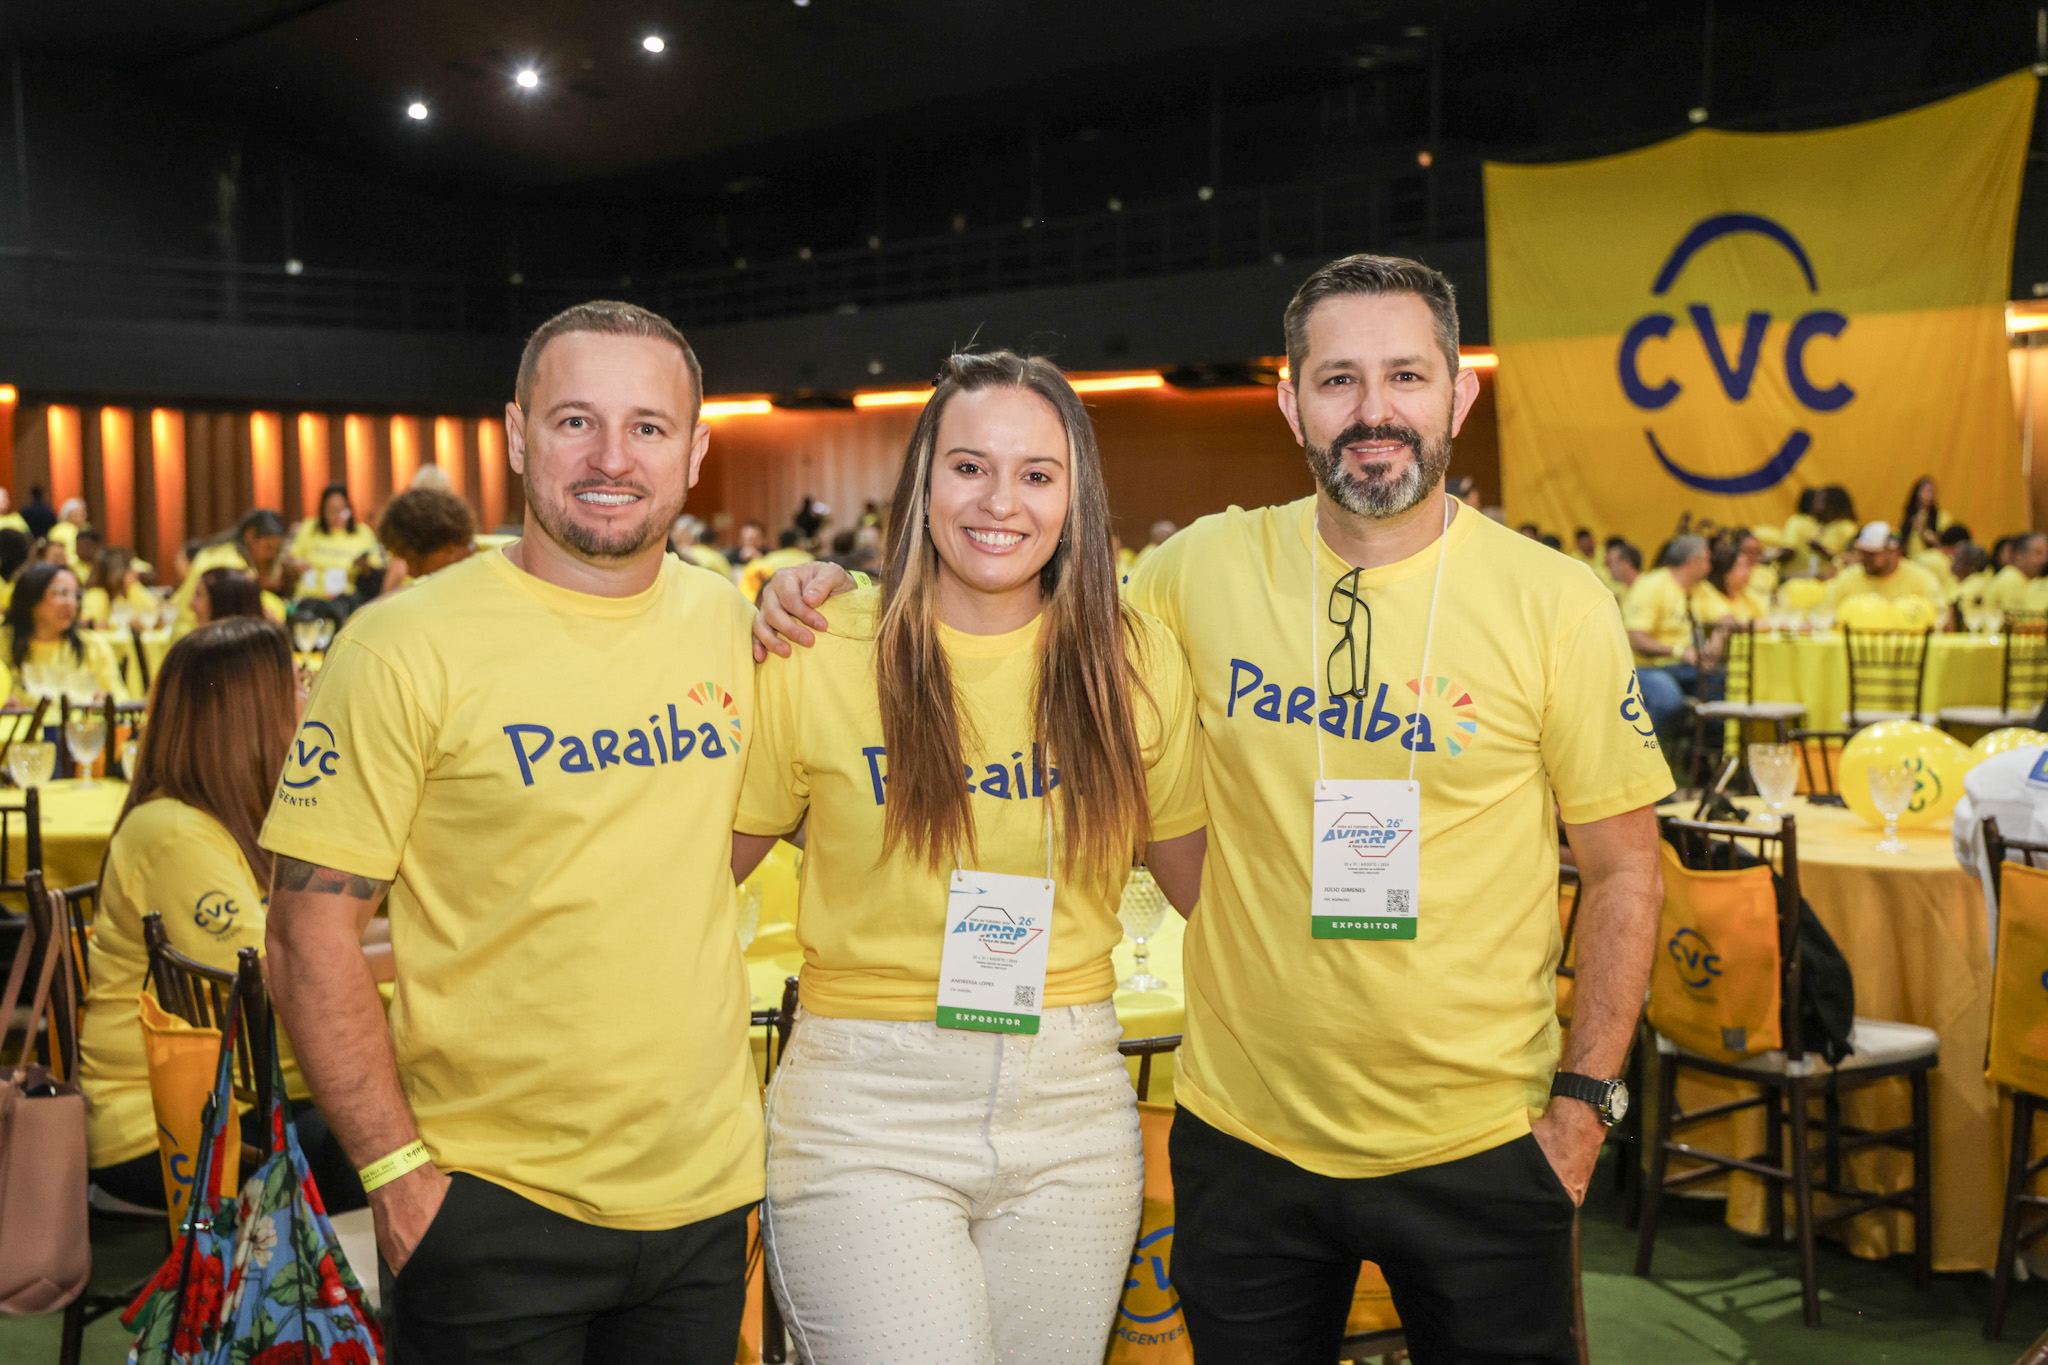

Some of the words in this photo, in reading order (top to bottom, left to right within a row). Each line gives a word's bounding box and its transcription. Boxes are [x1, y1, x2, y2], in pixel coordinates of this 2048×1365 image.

[1617, 303, 1857, 413] CVC
[288, 739, 341, 776] VC
[1321, 829, 1397, 844] AVIRRP
[194, 899, 239, 928] CVC
[952, 921, 1027, 941] AVIRRP
[1332, 921, 1398, 930] EXPOSITOR
[1668, 939, 1723, 976] CVC
[951, 978, 978, 986] ANDRESSA
[955, 1013, 1021, 1027] EXPOSITOR
[1115, 1323, 1185, 1346] AGENTES
